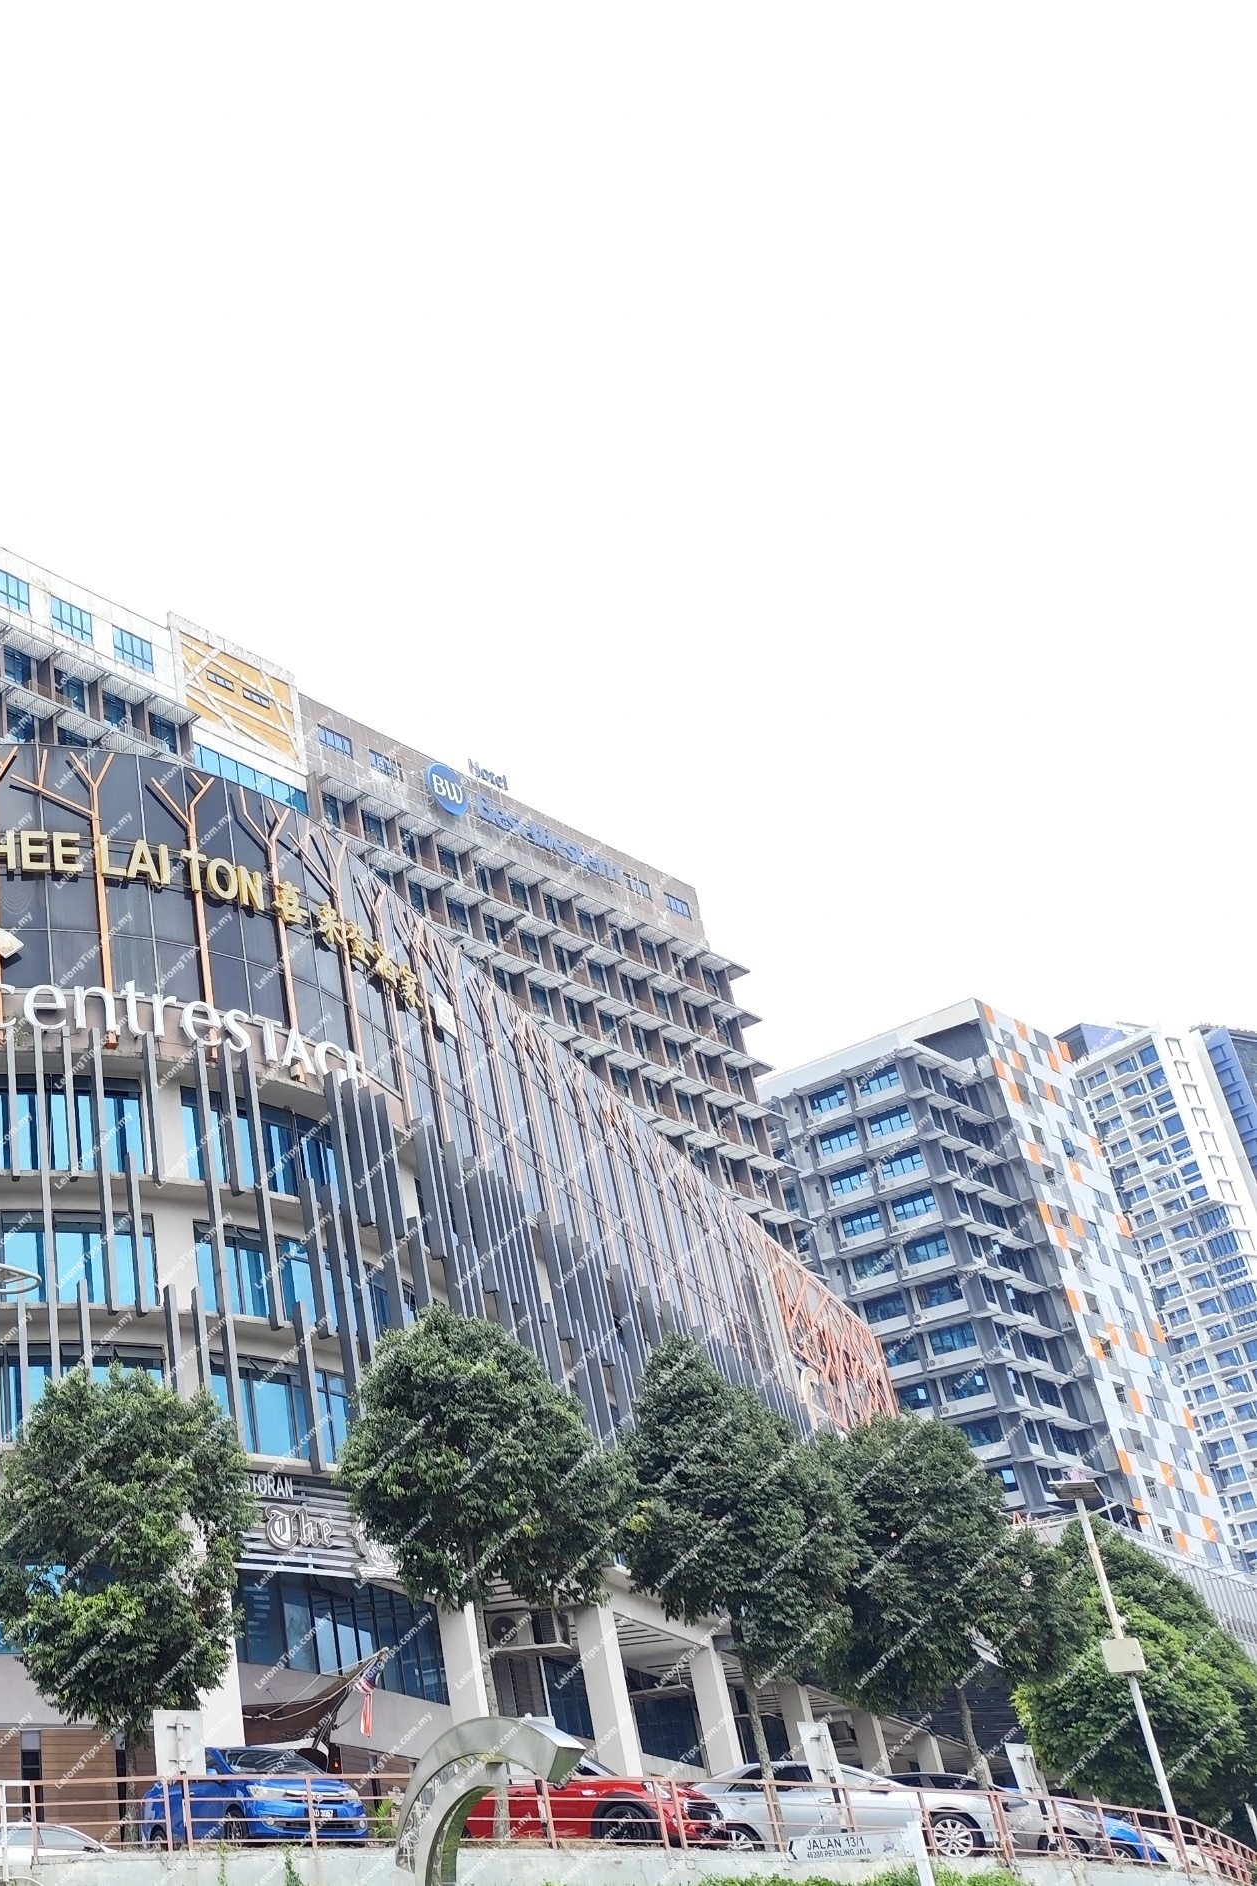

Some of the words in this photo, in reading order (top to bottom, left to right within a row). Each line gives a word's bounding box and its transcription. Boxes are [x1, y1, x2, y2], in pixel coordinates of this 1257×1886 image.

[431, 773, 464, 805] BW
[468, 759, 508, 790] Hotel
[98, 834, 171, 886] LAI
[180, 848, 266, 912] TON
[265, 1505, 335, 1550] The
[807, 1837, 842, 1850] JALAN
[845, 1836, 865, 1848] 13/1
[824, 1848, 855, 1858] PETALING
[856, 1847, 872, 1856] JAYA
